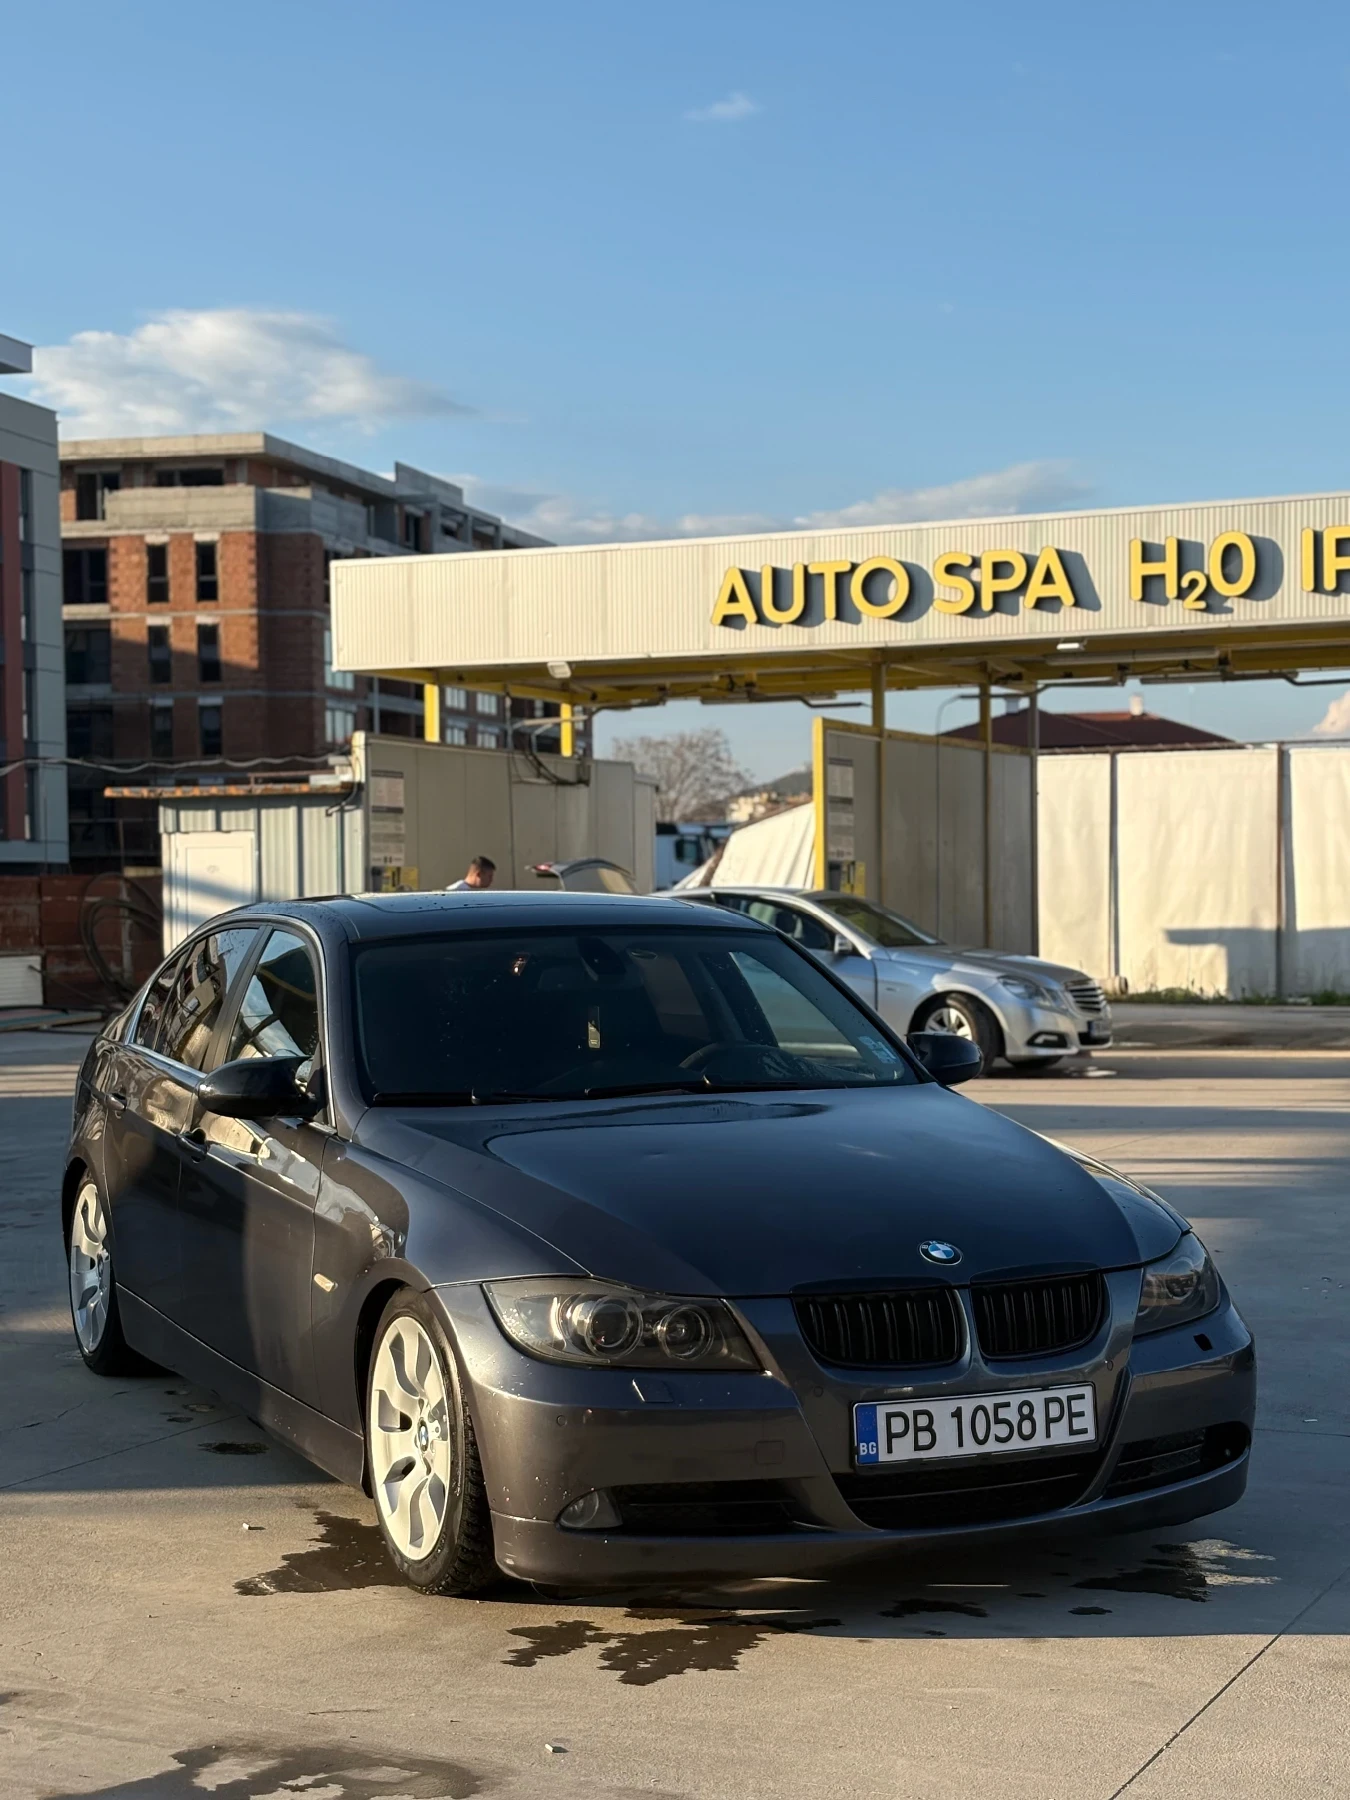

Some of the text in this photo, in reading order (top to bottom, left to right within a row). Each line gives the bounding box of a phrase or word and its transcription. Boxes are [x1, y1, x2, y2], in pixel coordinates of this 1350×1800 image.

[711, 555, 909, 625] AUTO
[933, 545, 1075, 616] SPA
[859, 1441, 878, 1456] BG
[885, 1393, 1089, 1454] PB 1058 PE
